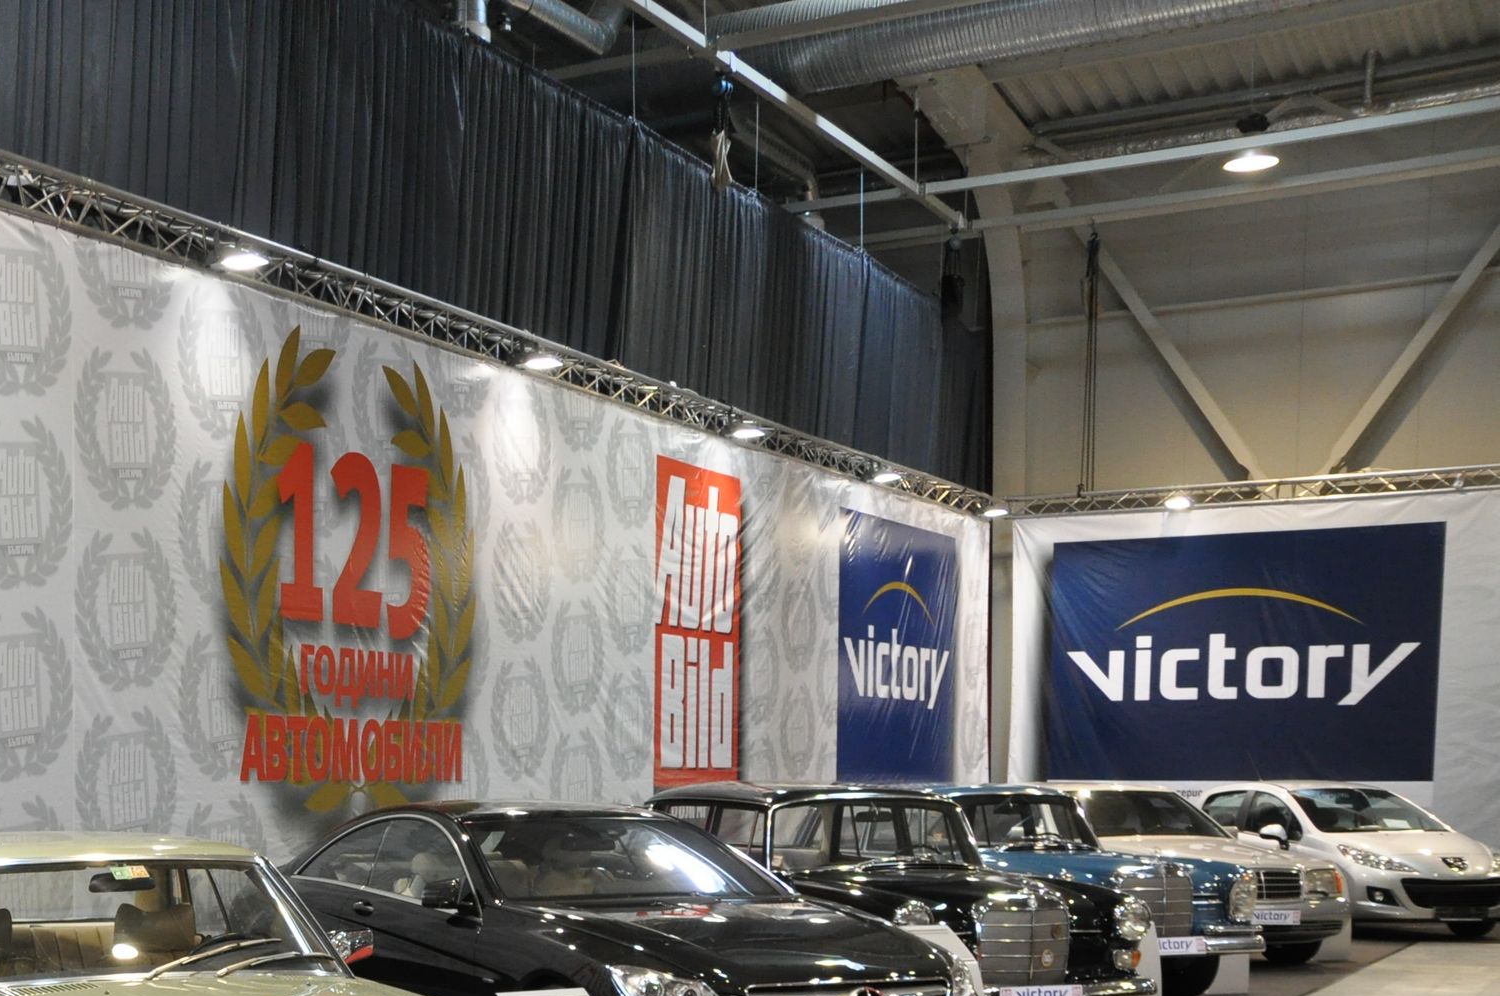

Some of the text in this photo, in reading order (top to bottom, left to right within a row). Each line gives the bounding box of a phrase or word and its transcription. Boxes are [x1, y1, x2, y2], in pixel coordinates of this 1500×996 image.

[276, 441, 430, 640] 125
[655, 474, 739, 634] Auto
[300, 643, 414, 708] ГОДИНИ
[660, 632, 734, 769] Bild
[844, 625, 950, 710] victory
[1066, 633, 1422, 706] victory
[240, 713, 463, 784] АВТОМОБИЛИ
[1158, 939, 1193, 951] ictory
